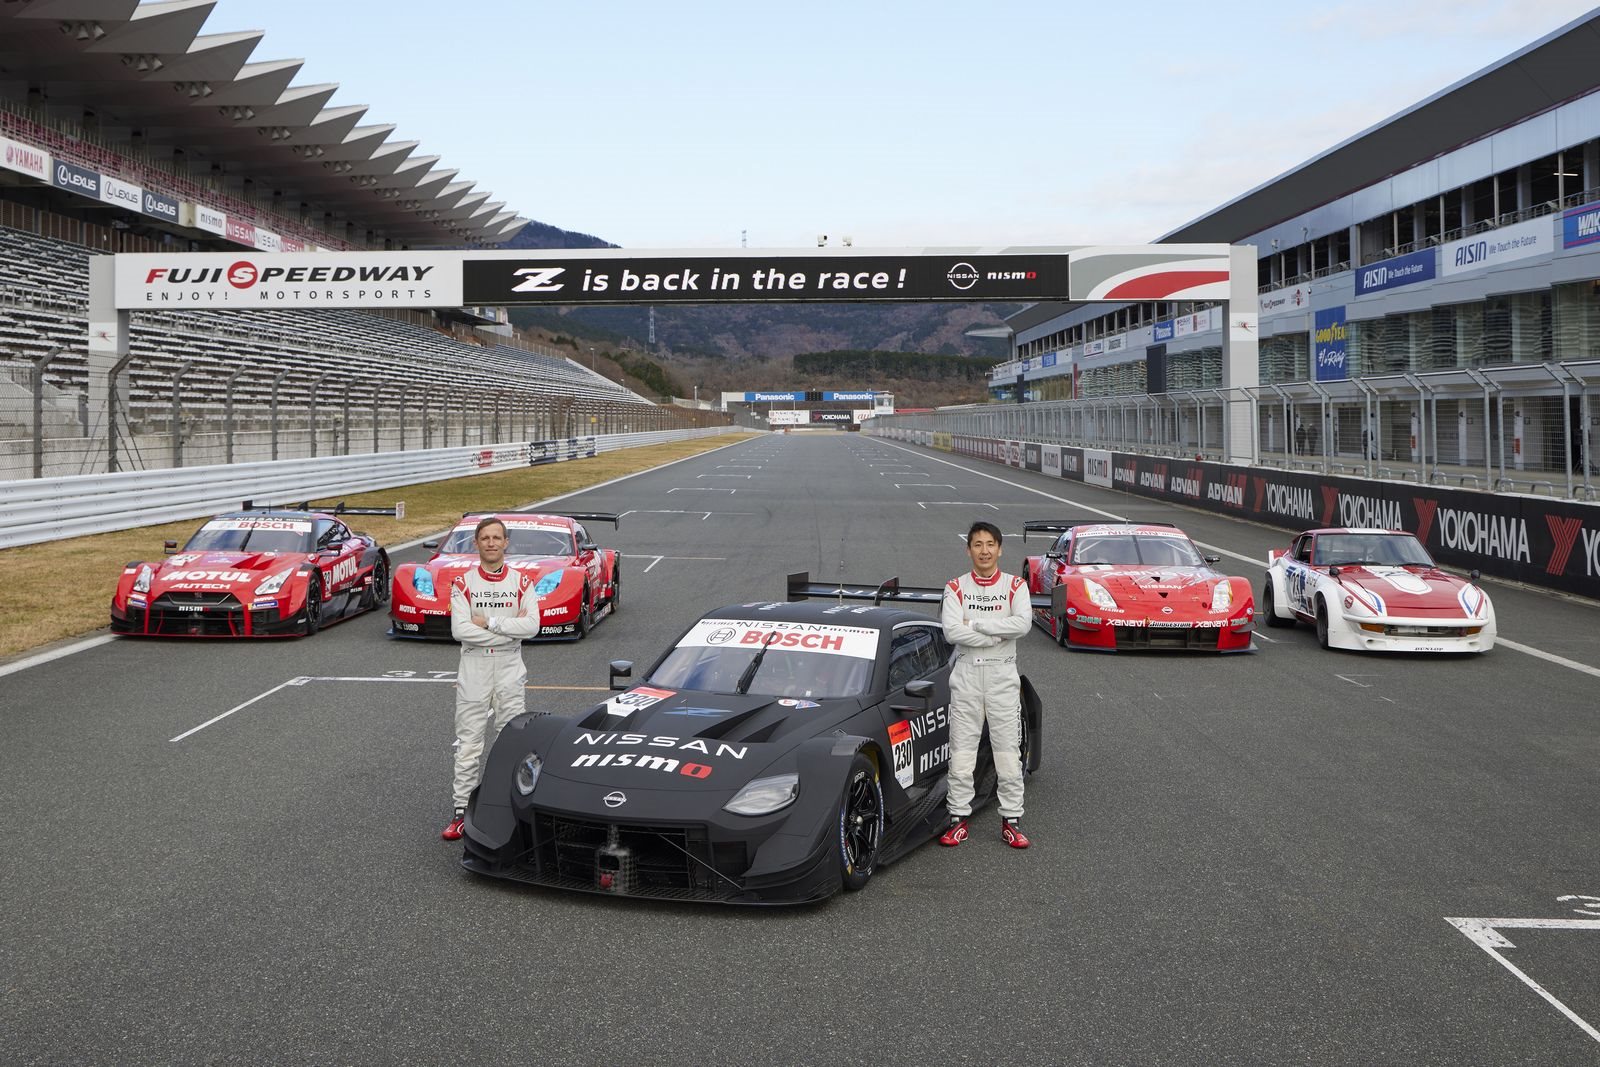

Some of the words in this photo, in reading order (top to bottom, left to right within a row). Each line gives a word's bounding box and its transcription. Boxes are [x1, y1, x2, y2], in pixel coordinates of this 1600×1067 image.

[15, 147, 43, 173] YAMAHA
[68, 173, 96, 191] LEXUS
[114, 188, 138, 203] LEXUS
[153, 203, 176, 216] LEXUS
[227, 223, 255, 242] NISSAN
[1455, 241, 1487, 266] AISIN
[1489, 245, 1496, 254] We
[1497, 240, 1511, 252] Touch
[1512, 239, 1520, 249] the
[1520, 236, 1537, 247] Future
[145, 268, 223, 284] FUJI
[228, 264, 433, 286] SPEEDWAY
[511, 267, 566, 292] Z
[582, 269, 609, 291] is
[620, 268, 700, 291] back
[710, 268, 740, 290] in
[752, 268, 806, 290] the
[987, 271, 1037, 280] nismo
[1363, 266, 1387, 288] AISIN
[1388, 270, 1394, 278] We
[1394, 267, 1404, 277] Touch
[1411, 264, 1423, 274] Future
[146, 292, 228, 301] ENJOY!
[260, 289, 432, 300] MOTORSPORTS
[755, 393, 795, 401] Panasonic
[1114, 467, 1135, 484] ADVAN
[1140, 471, 1165, 490] ADVAN
[1170, 476, 1200, 497] ADVAN
[1207, 482, 1243, 505] ADVAN
[1265, 483, 1314, 520] YOKOHAMA
[1337, 493, 1402, 530] YOKOHAMA
[238, 521, 294, 529] BOSCH
[1437, 507, 1531, 563] YOKOHAMA
[160, 571, 251, 582] MOTUL
[332, 556, 357, 585] MOTUL
[963, 594, 1007, 602] NISSAN
[399, 605, 417, 614] MOTUL
[543, 607, 568, 617] MOTUL
[738, 621, 822, 632] NISSAN
[1106, 619, 1146, 627] xanavi
[1195, 618, 1228, 628] xanavi
[739, 630, 844, 650] BOSCH
[381, 670, 458, 678] 37
[909, 702, 951, 741] NISS
[573, 732, 748, 760] NISSAN
[895, 739, 912, 772] 230
[570, 753, 713, 779] nismo
